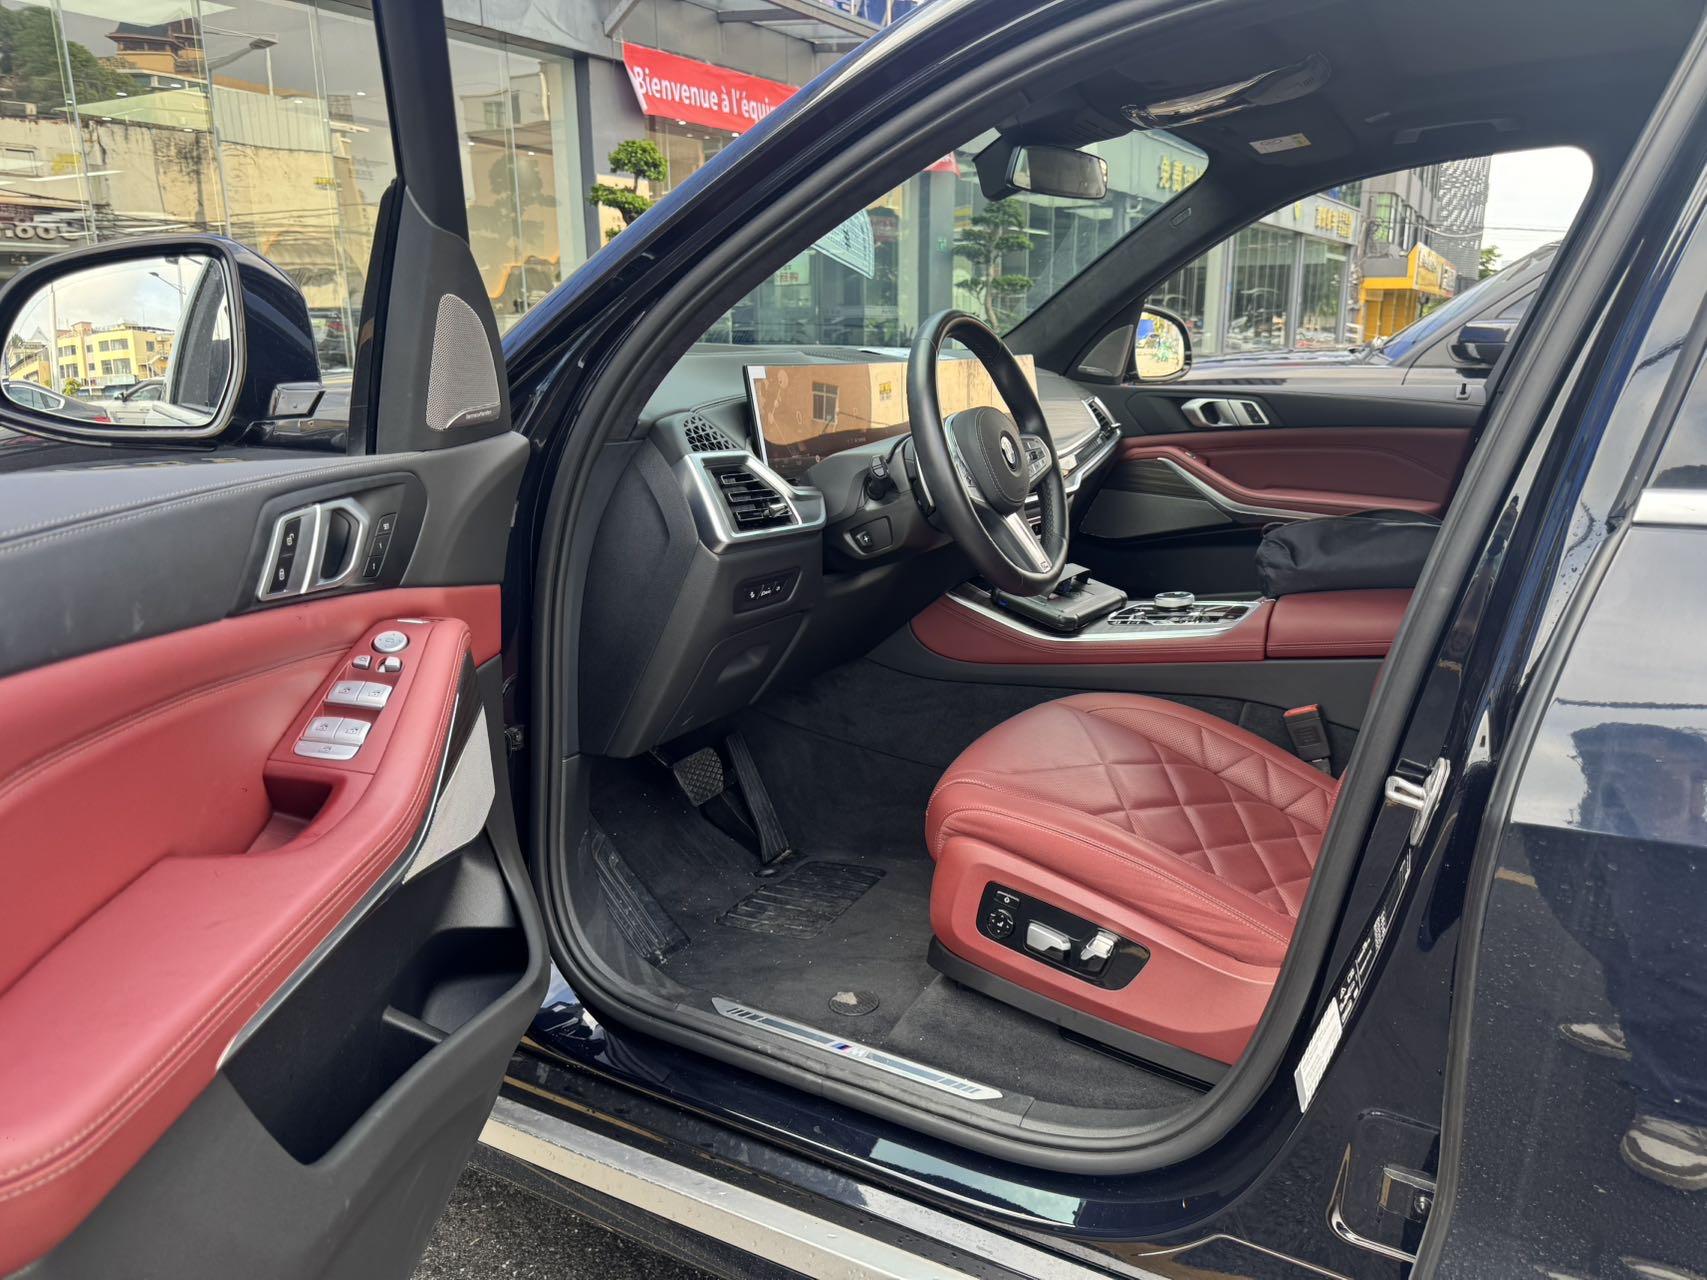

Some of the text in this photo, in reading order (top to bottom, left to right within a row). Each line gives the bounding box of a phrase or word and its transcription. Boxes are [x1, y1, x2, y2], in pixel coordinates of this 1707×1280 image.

[633, 66, 777, 124] Bienvenue à l'équi
